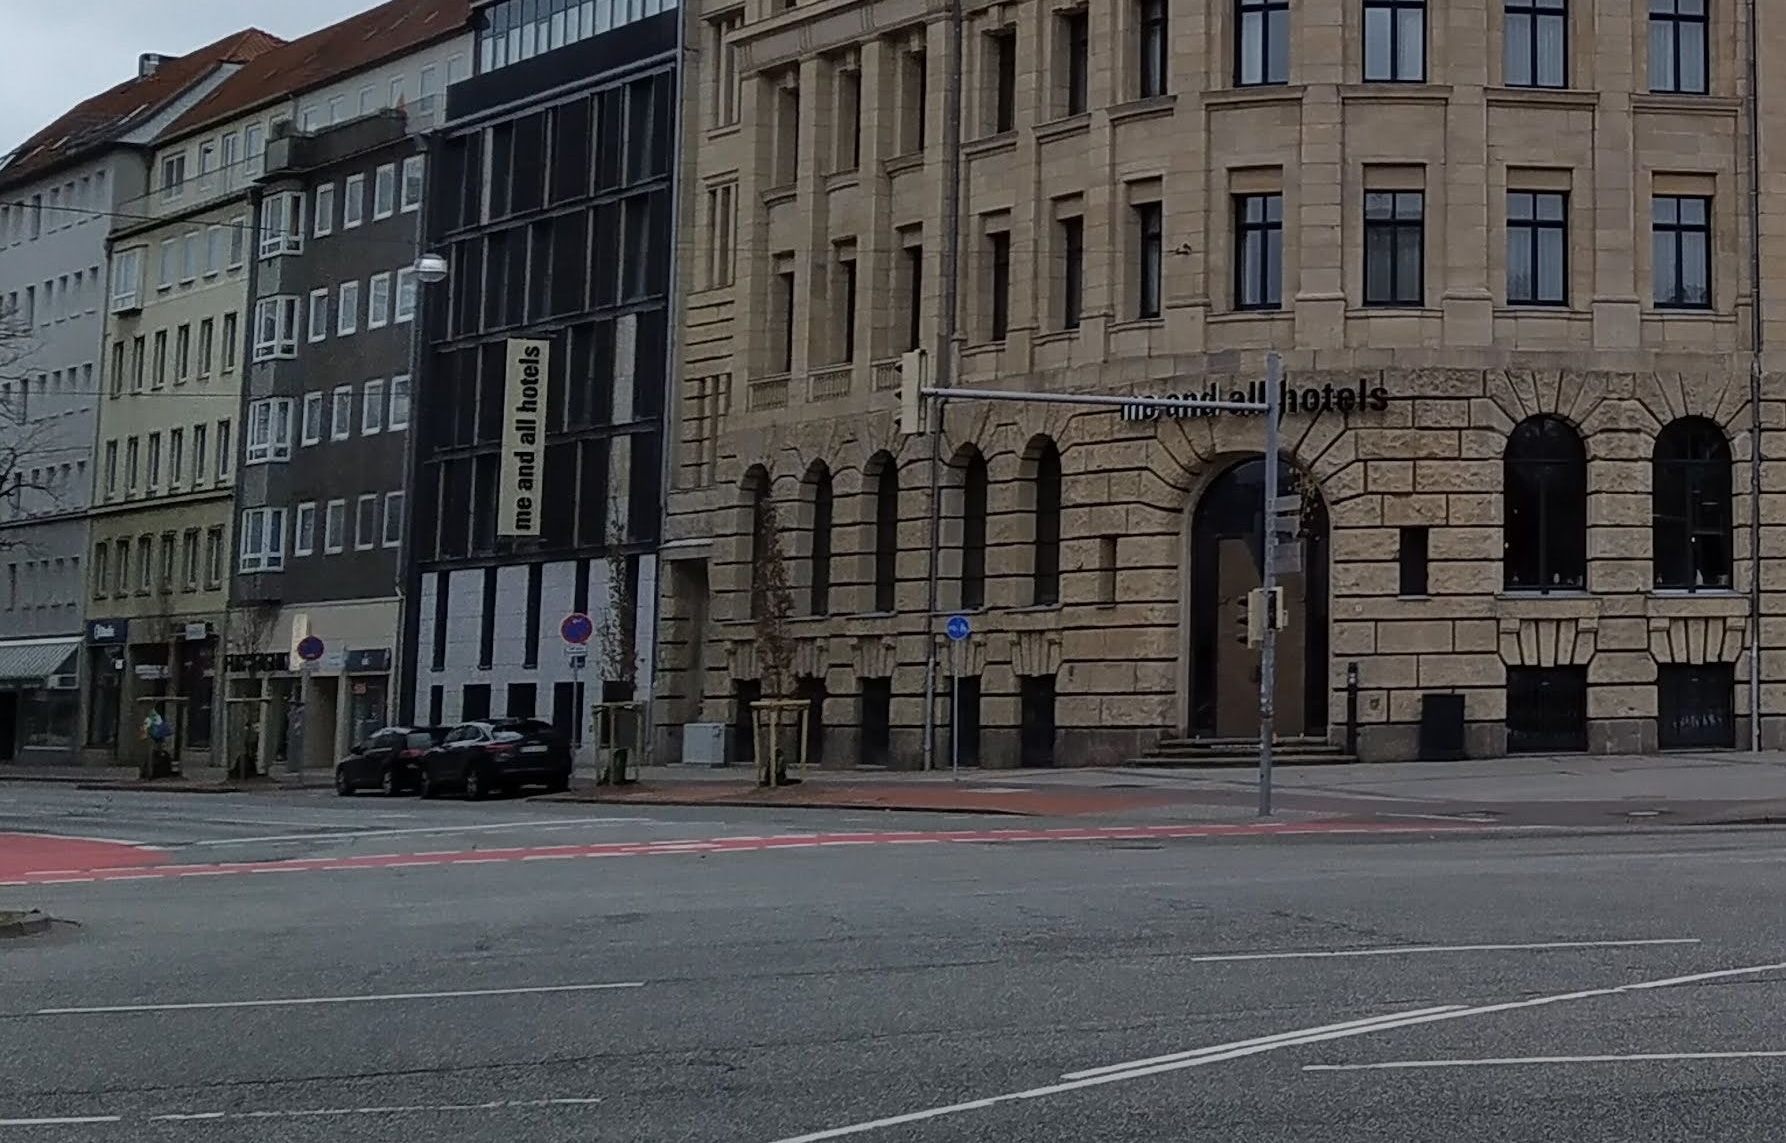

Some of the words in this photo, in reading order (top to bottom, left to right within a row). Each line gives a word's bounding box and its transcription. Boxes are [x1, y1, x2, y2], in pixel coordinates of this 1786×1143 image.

[516, 345, 541, 413] hotels
[1166, 382, 1220, 418] and
[1229, 381, 1267, 416] all
[1281, 378, 1389, 413] hotels
[515, 419, 537, 445] all
[514, 451, 535, 491] and
[515, 497, 533, 531] me
